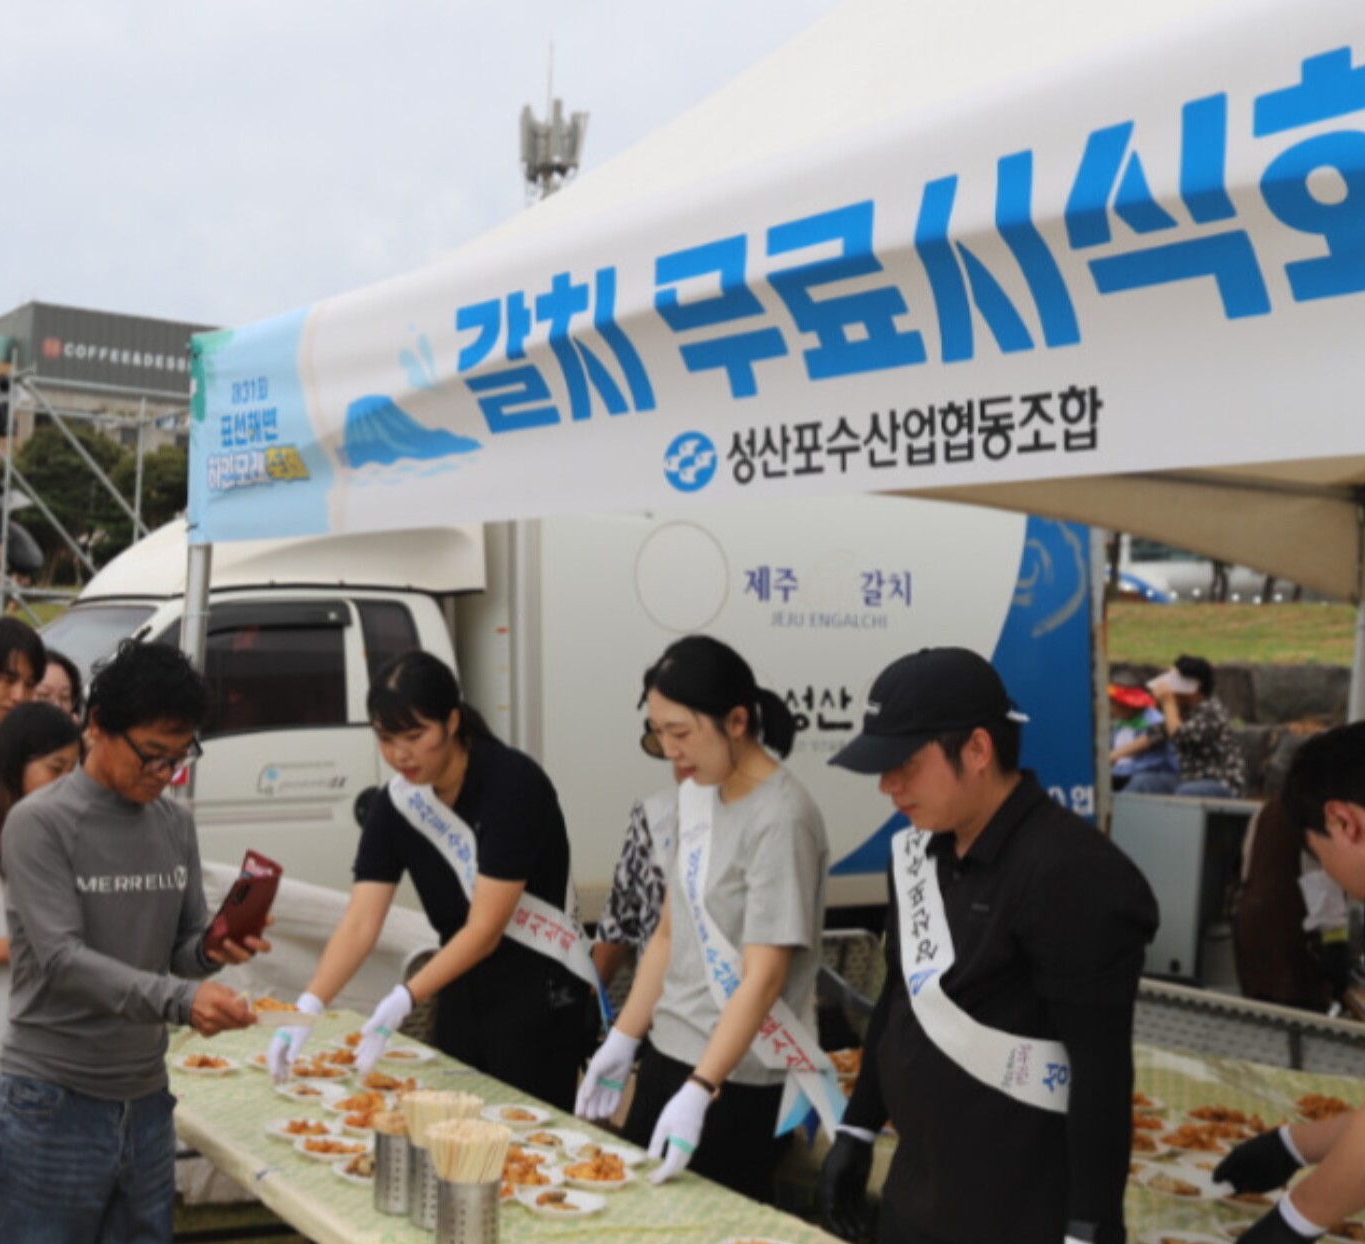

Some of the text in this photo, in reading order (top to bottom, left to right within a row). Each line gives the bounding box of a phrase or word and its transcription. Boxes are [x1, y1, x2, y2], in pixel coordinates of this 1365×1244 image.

[456, 266, 657, 434] 갈치
[726, 385, 1104, 486] 성산포수산업협동조합
[744, 566, 912, 607] 제주 갈치
[77, 874, 174, 893] MERRELL
